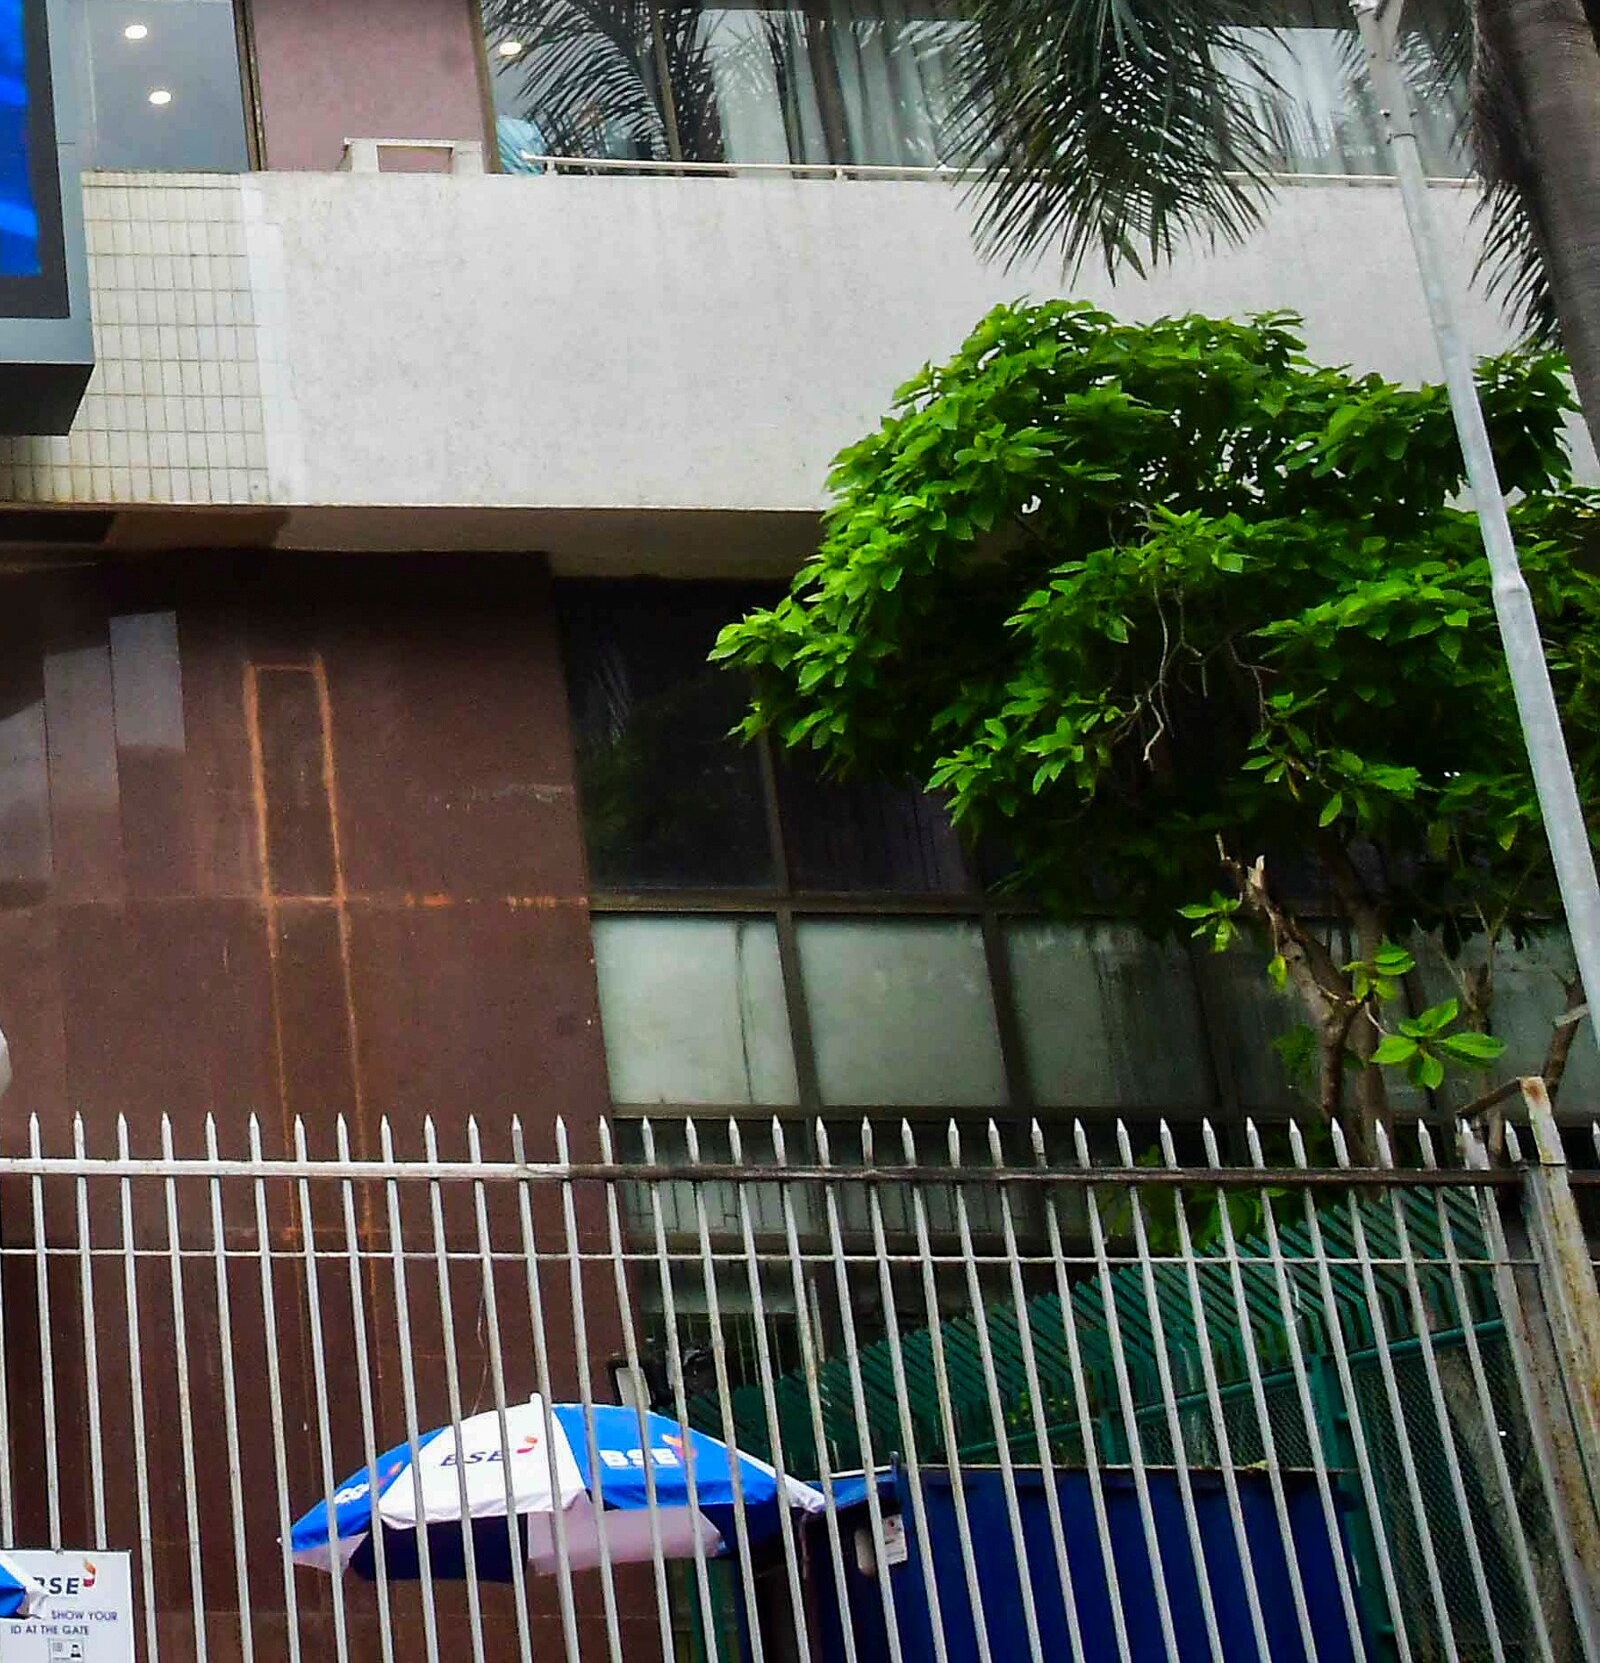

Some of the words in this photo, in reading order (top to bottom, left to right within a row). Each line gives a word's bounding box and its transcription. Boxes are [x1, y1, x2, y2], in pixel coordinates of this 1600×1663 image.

[598, 1447, 680, 1467] BSE
[50, 1609, 85, 1622] SHOW
[88, 1610, 119, 1622] YOUR
[9, 1624, 23, 1636] ID
[25, 1624, 38, 1636] AT
[40, 1624, 59, 1636] THE
[61, 1624, 91, 1637] GATE
